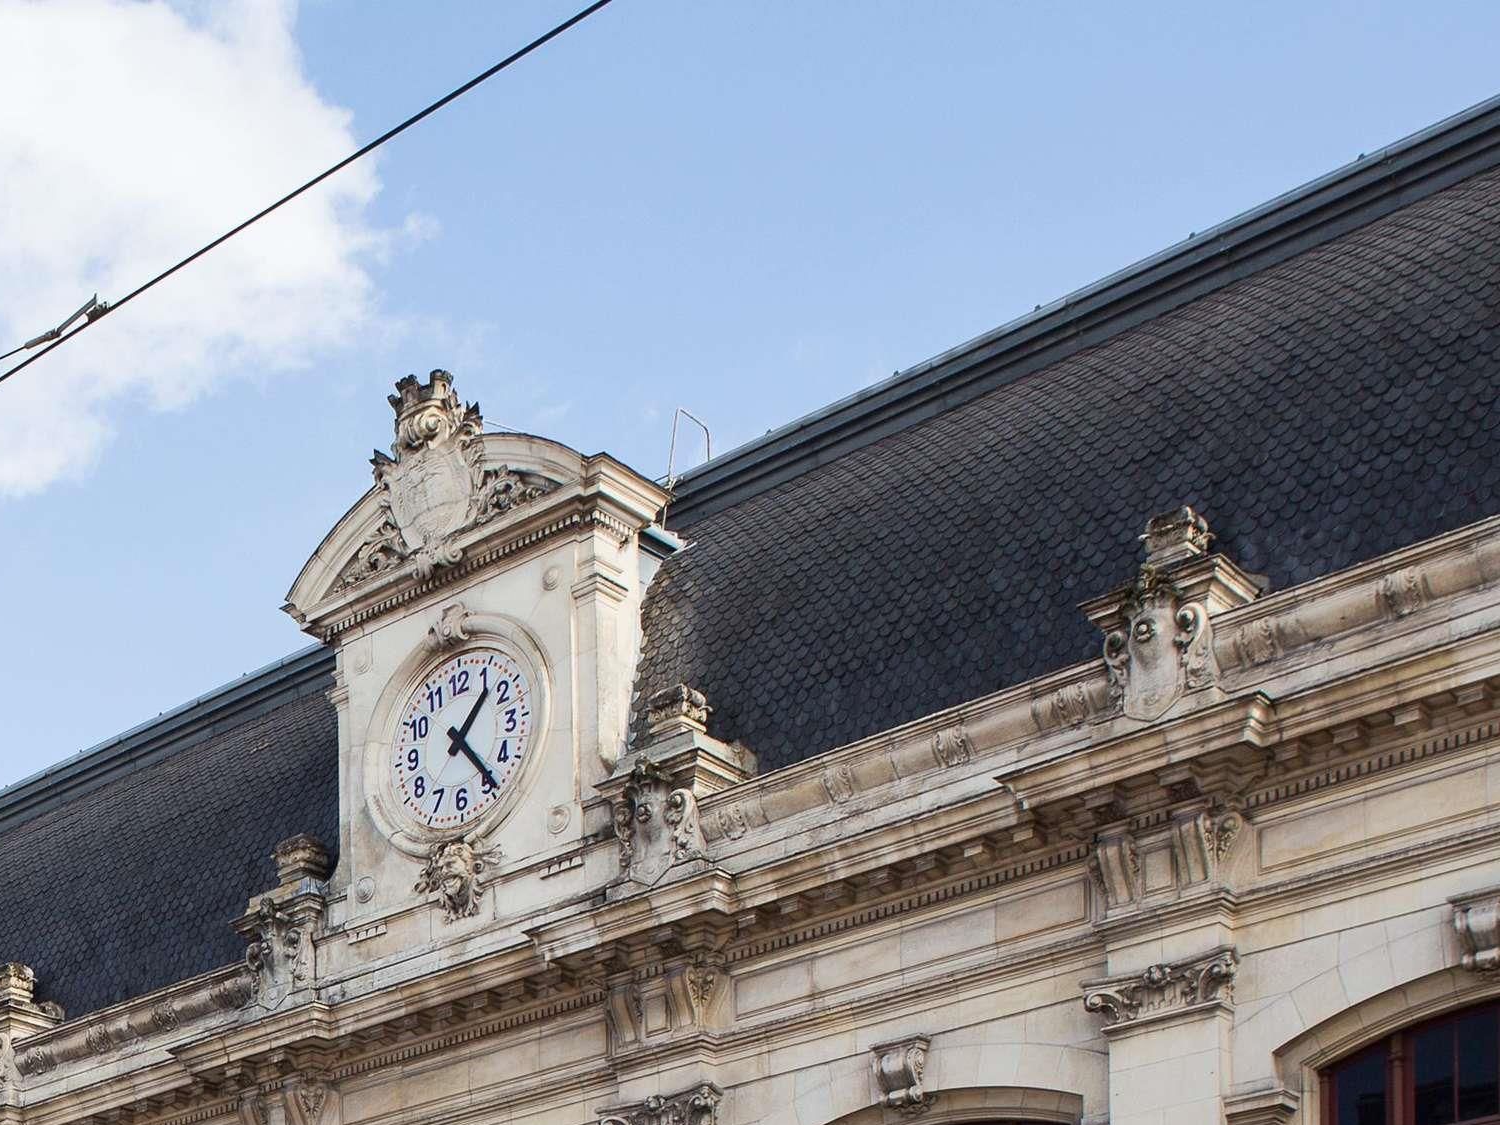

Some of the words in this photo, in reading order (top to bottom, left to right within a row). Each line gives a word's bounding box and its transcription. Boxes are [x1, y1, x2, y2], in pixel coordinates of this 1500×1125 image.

[449, 670, 469, 696] 12
[479, 667, 488, 690] 1
[426, 686, 443, 713] 11
[496, 680, 510, 705] 2
[410, 716, 429, 741] 10
[504, 708, 517, 733] 3
[407, 748, 419, 771] 9
[497, 740, 509, 763] 4
[414, 776, 425, 798] 8
[455, 788, 468, 811] 6
[432, 788, 445, 813] 7
